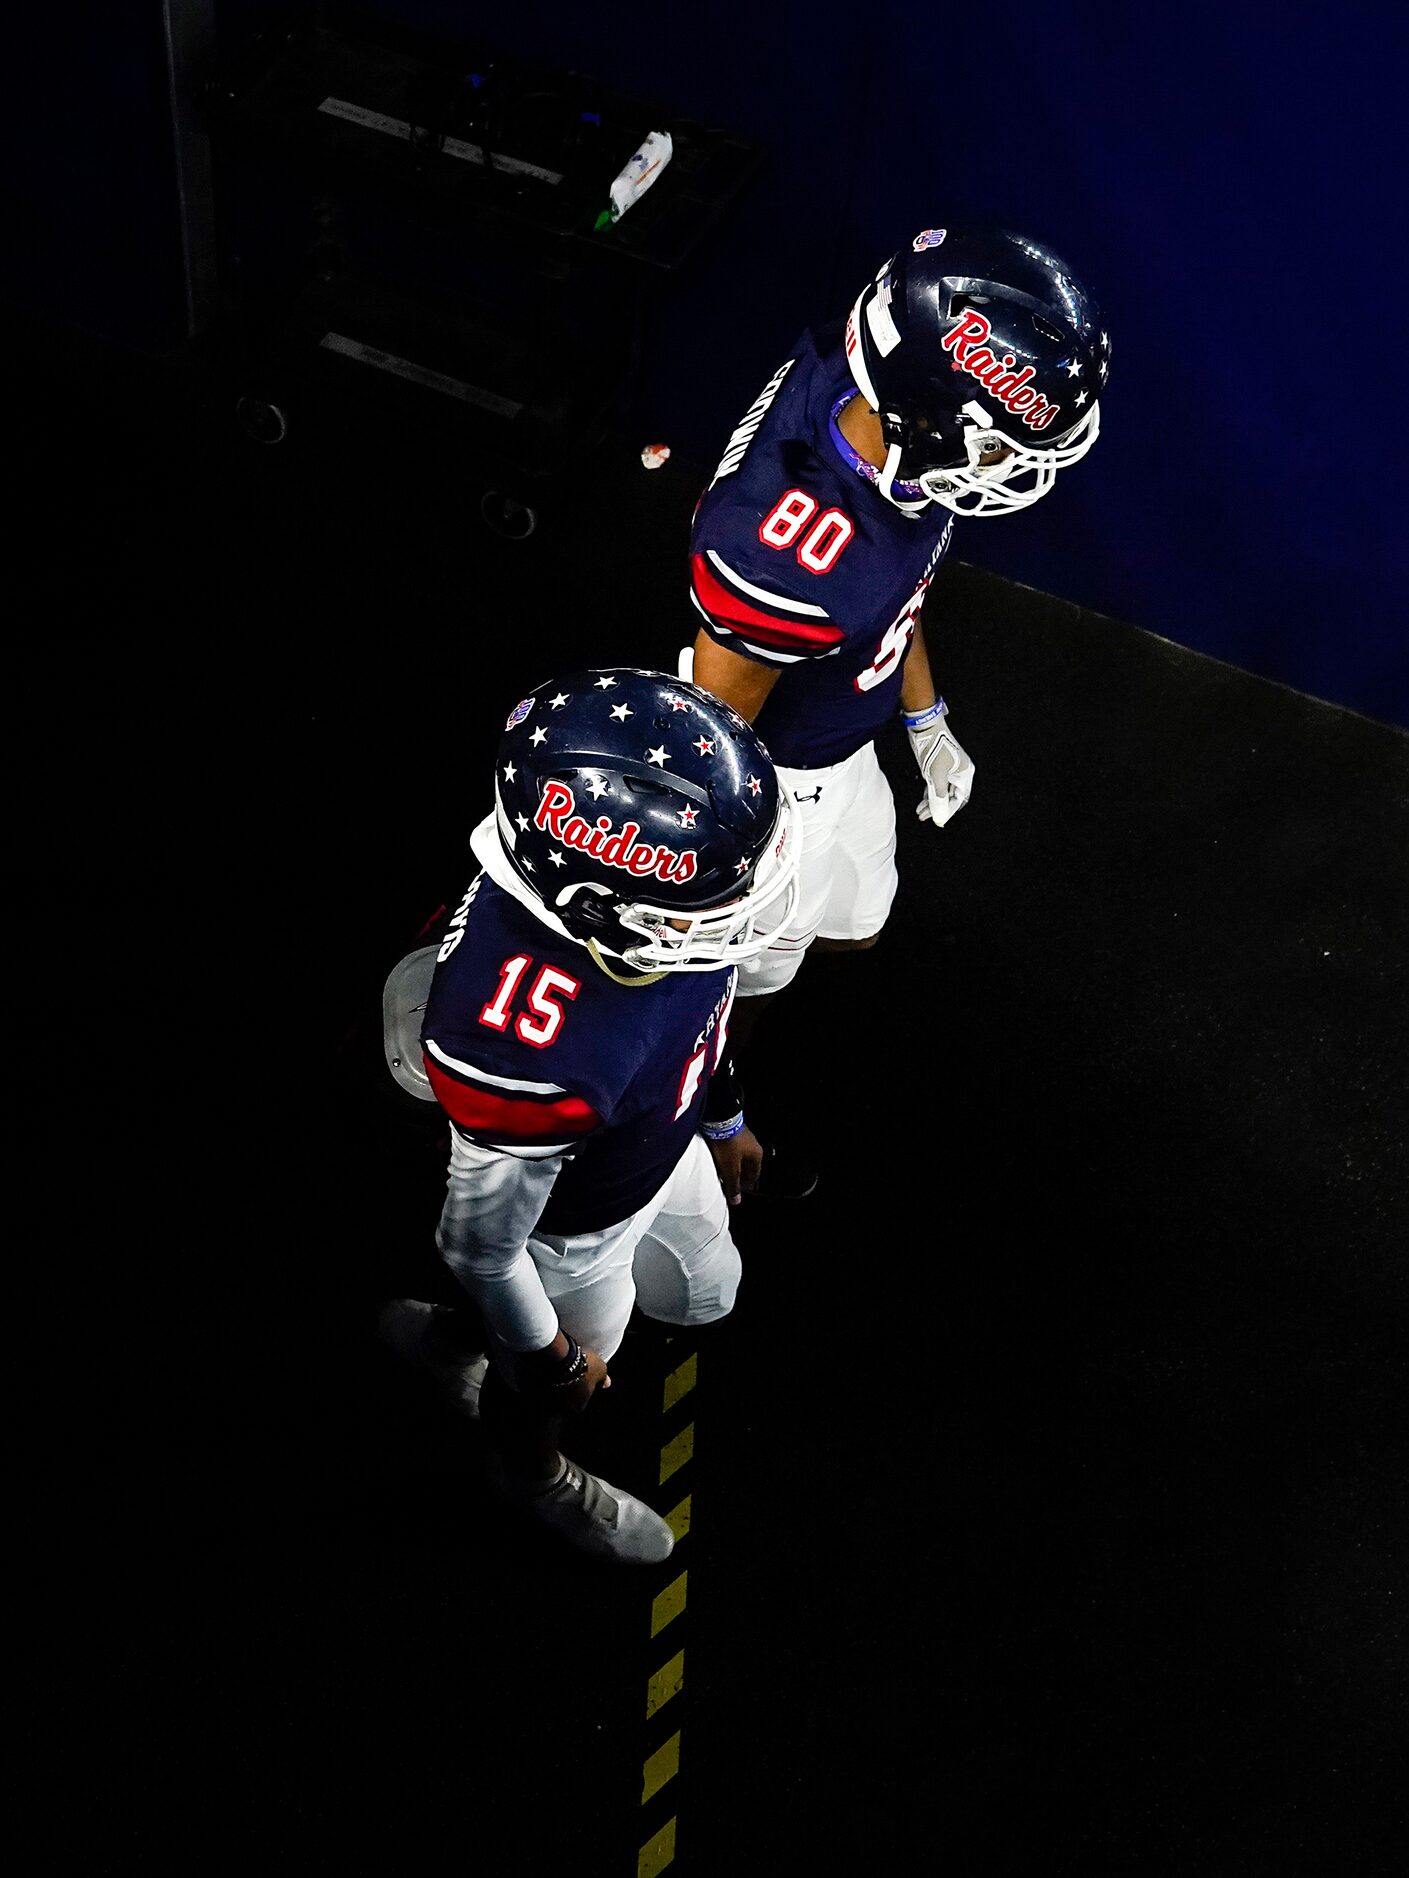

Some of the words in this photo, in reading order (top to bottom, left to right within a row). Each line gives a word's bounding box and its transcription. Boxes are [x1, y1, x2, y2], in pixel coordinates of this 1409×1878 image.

[941, 306, 1060, 431] Raiders
[759, 488, 855, 575] 80
[534, 780, 698, 884] Raiders
[479, 953, 582, 1049] 15
